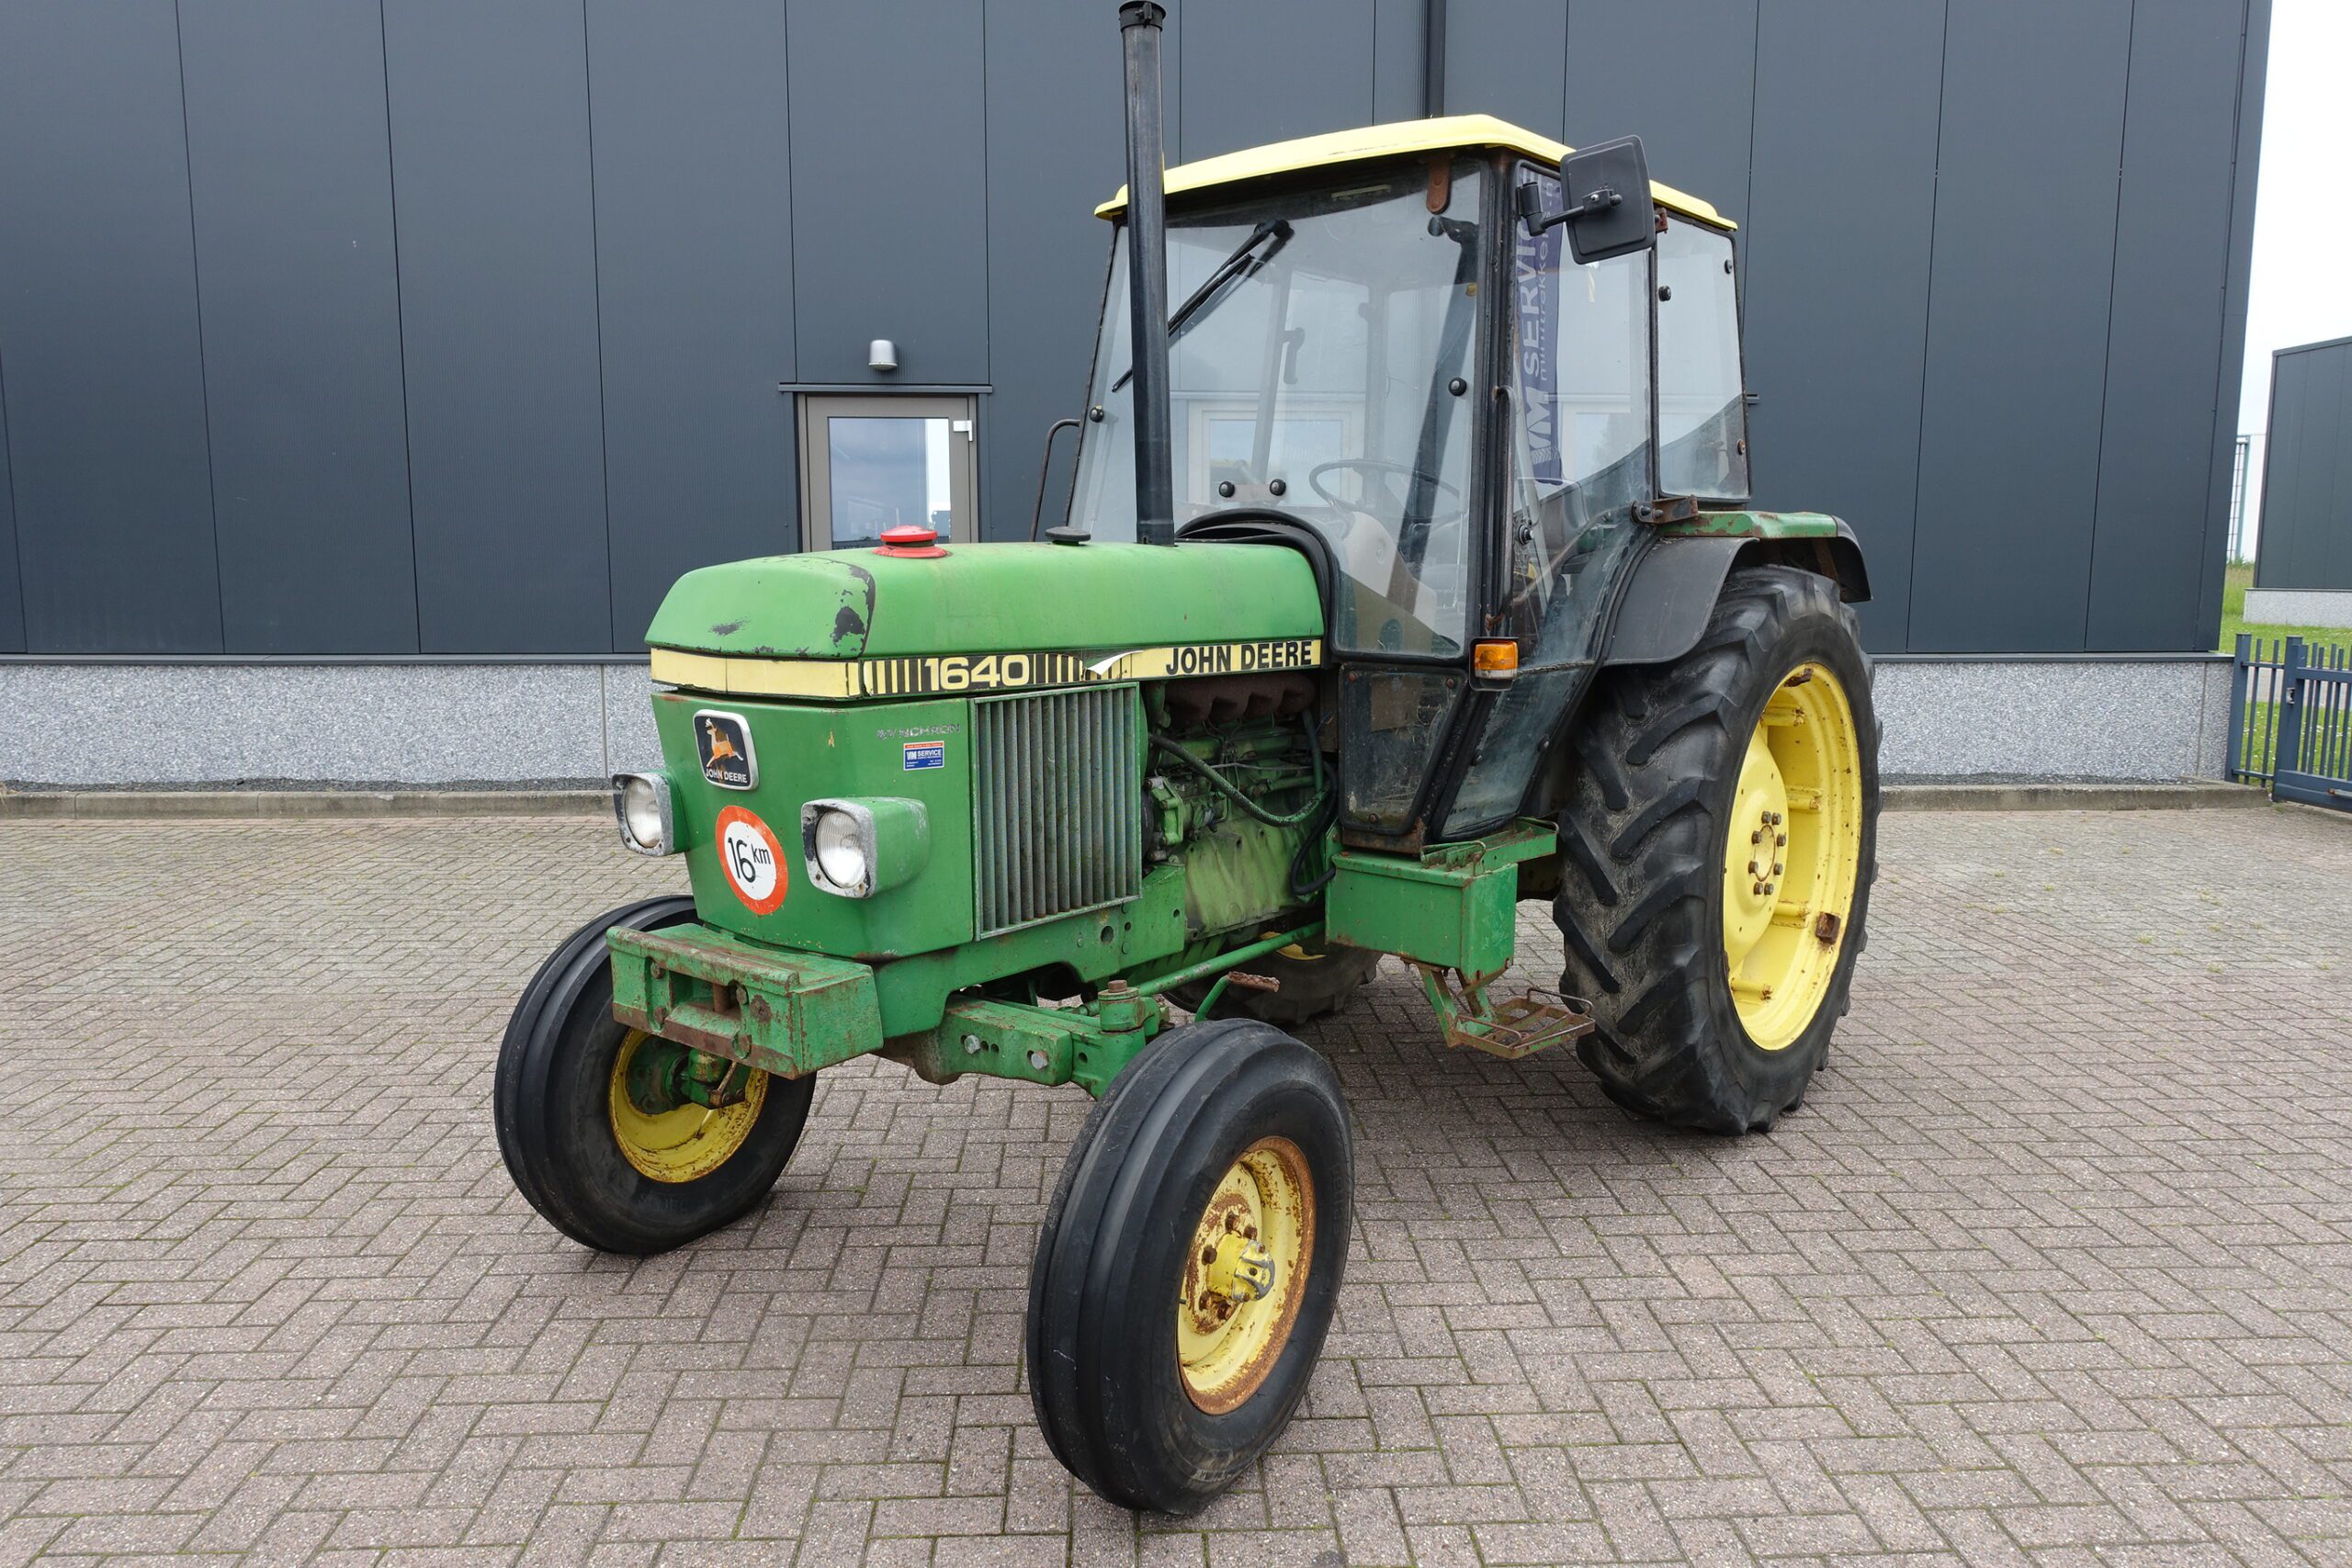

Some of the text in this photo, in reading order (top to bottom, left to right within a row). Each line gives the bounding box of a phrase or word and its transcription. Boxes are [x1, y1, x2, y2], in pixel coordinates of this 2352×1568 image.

[925, 655, 1030, 691] 1640
[1166, 641, 1312, 675] JOHN DEERE
[906, 750, 917, 761] VM
[917, 749, 942, 757] SERVICE
[706, 768, 748, 783] JOHN DEERE
[728, 837, 771, 883] 16 km
